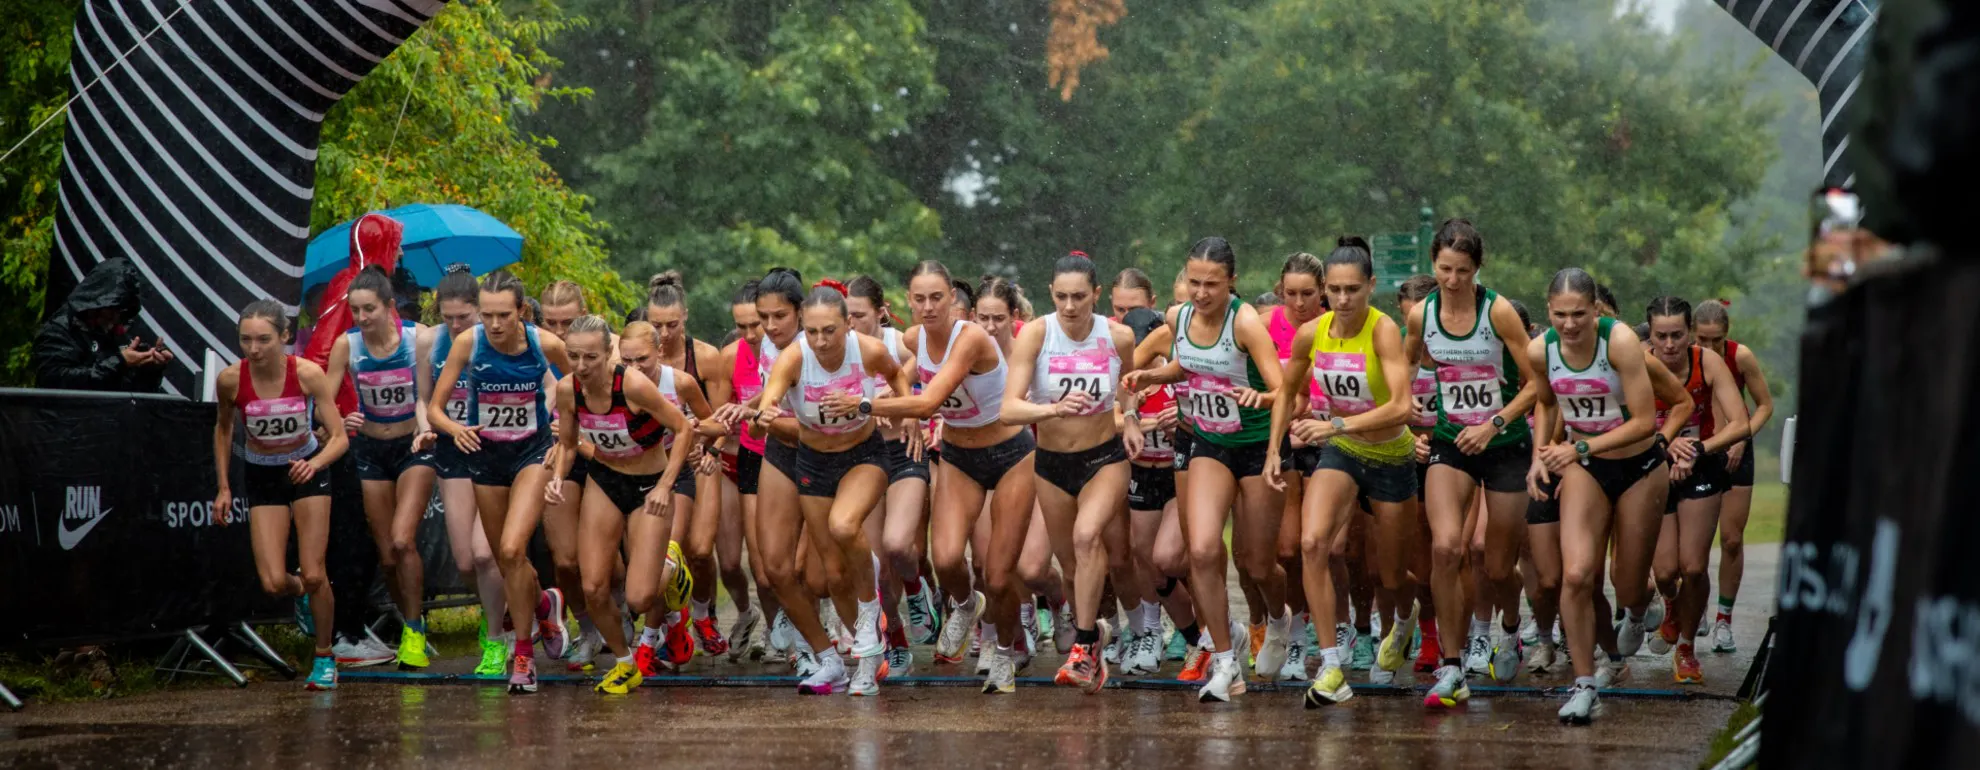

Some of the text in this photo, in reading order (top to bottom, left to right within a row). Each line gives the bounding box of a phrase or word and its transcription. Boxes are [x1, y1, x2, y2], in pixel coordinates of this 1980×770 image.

[371, 386, 406, 406] 198
[481, 381, 537, 392] SCOTLAND
[1323, 373, 1360, 397] 169
[1193, 392, 1230, 419] 218
[1449, 384, 1493, 409] 206
[1567, 395, 1606, 418] 197
[255, 416, 298, 437] 230
[487, 406, 528, 428] 228
[589, 432, 628, 450] 184
[65, 485, 101, 520] RUN
